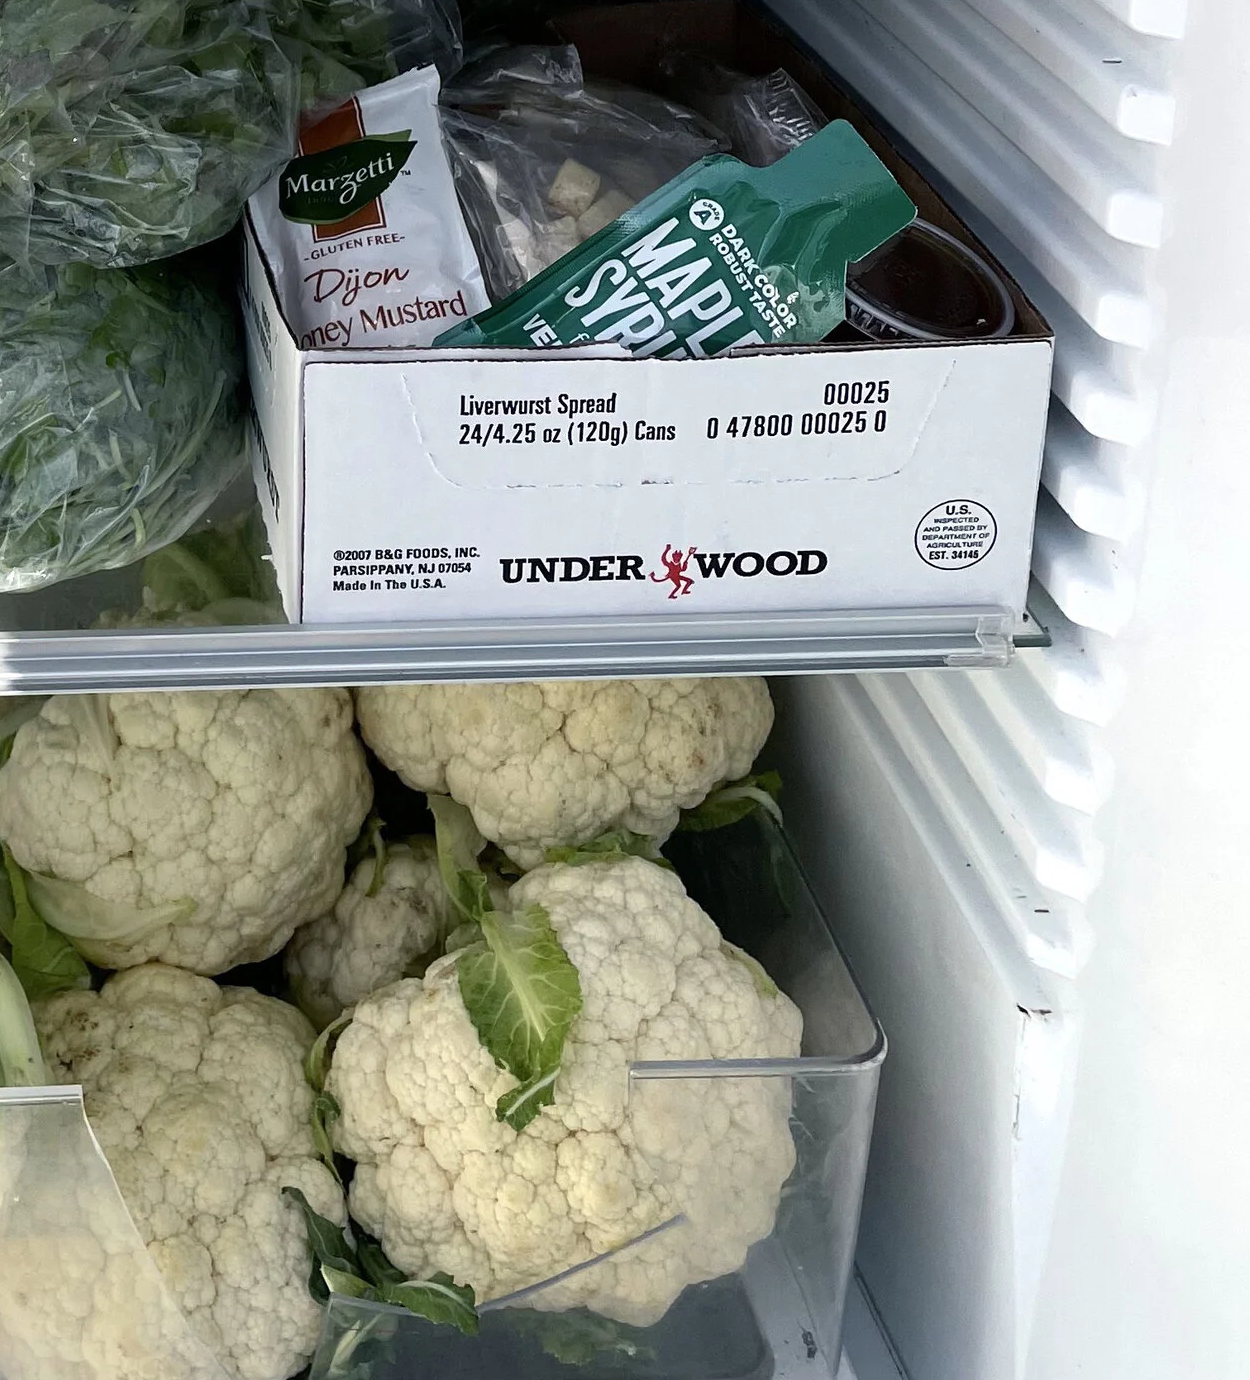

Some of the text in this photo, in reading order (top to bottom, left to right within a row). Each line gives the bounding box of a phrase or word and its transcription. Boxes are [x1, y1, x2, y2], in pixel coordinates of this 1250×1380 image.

[285, 152, 395, 205] Marzetti
[694, 210, 712, 225] A
[703, 202, 720, 221] GRADE
[304, 268, 410, 306] Dijon
[709, 233, 786, 338] ROBUST TASTE
[721, 224, 760, 274] DARK
[754, 275, 797, 329] COLOR
[300, 317, 353, 350] oney
[360, 290, 467, 333] Mustard
[523, 313, 563, 346] VE
[460, 393, 616, 418] Liverwurst Spread
[824, 381, 890, 406] 00025
[459, 420, 676, 448] 24/4.25 oz (120g) Cans
[707, 410, 886, 440] 0 47800 00025 0
[946, 505, 971, 515] U.S.
[922, 533, 976, 541] DEPARTMENT
[375, 549, 404, 561] B&G
[406, 548, 451, 561] FOODS,
[454, 548, 480, 559] INC.
[499, 550, 828, 584] UNDER WOOD
[929, 550, 979, 560] EST. 34145
[333, 562, 471, 577] PARSIPPANY, NJ 07054
[333, 577, 446, 591] Made In The U.S.A.
